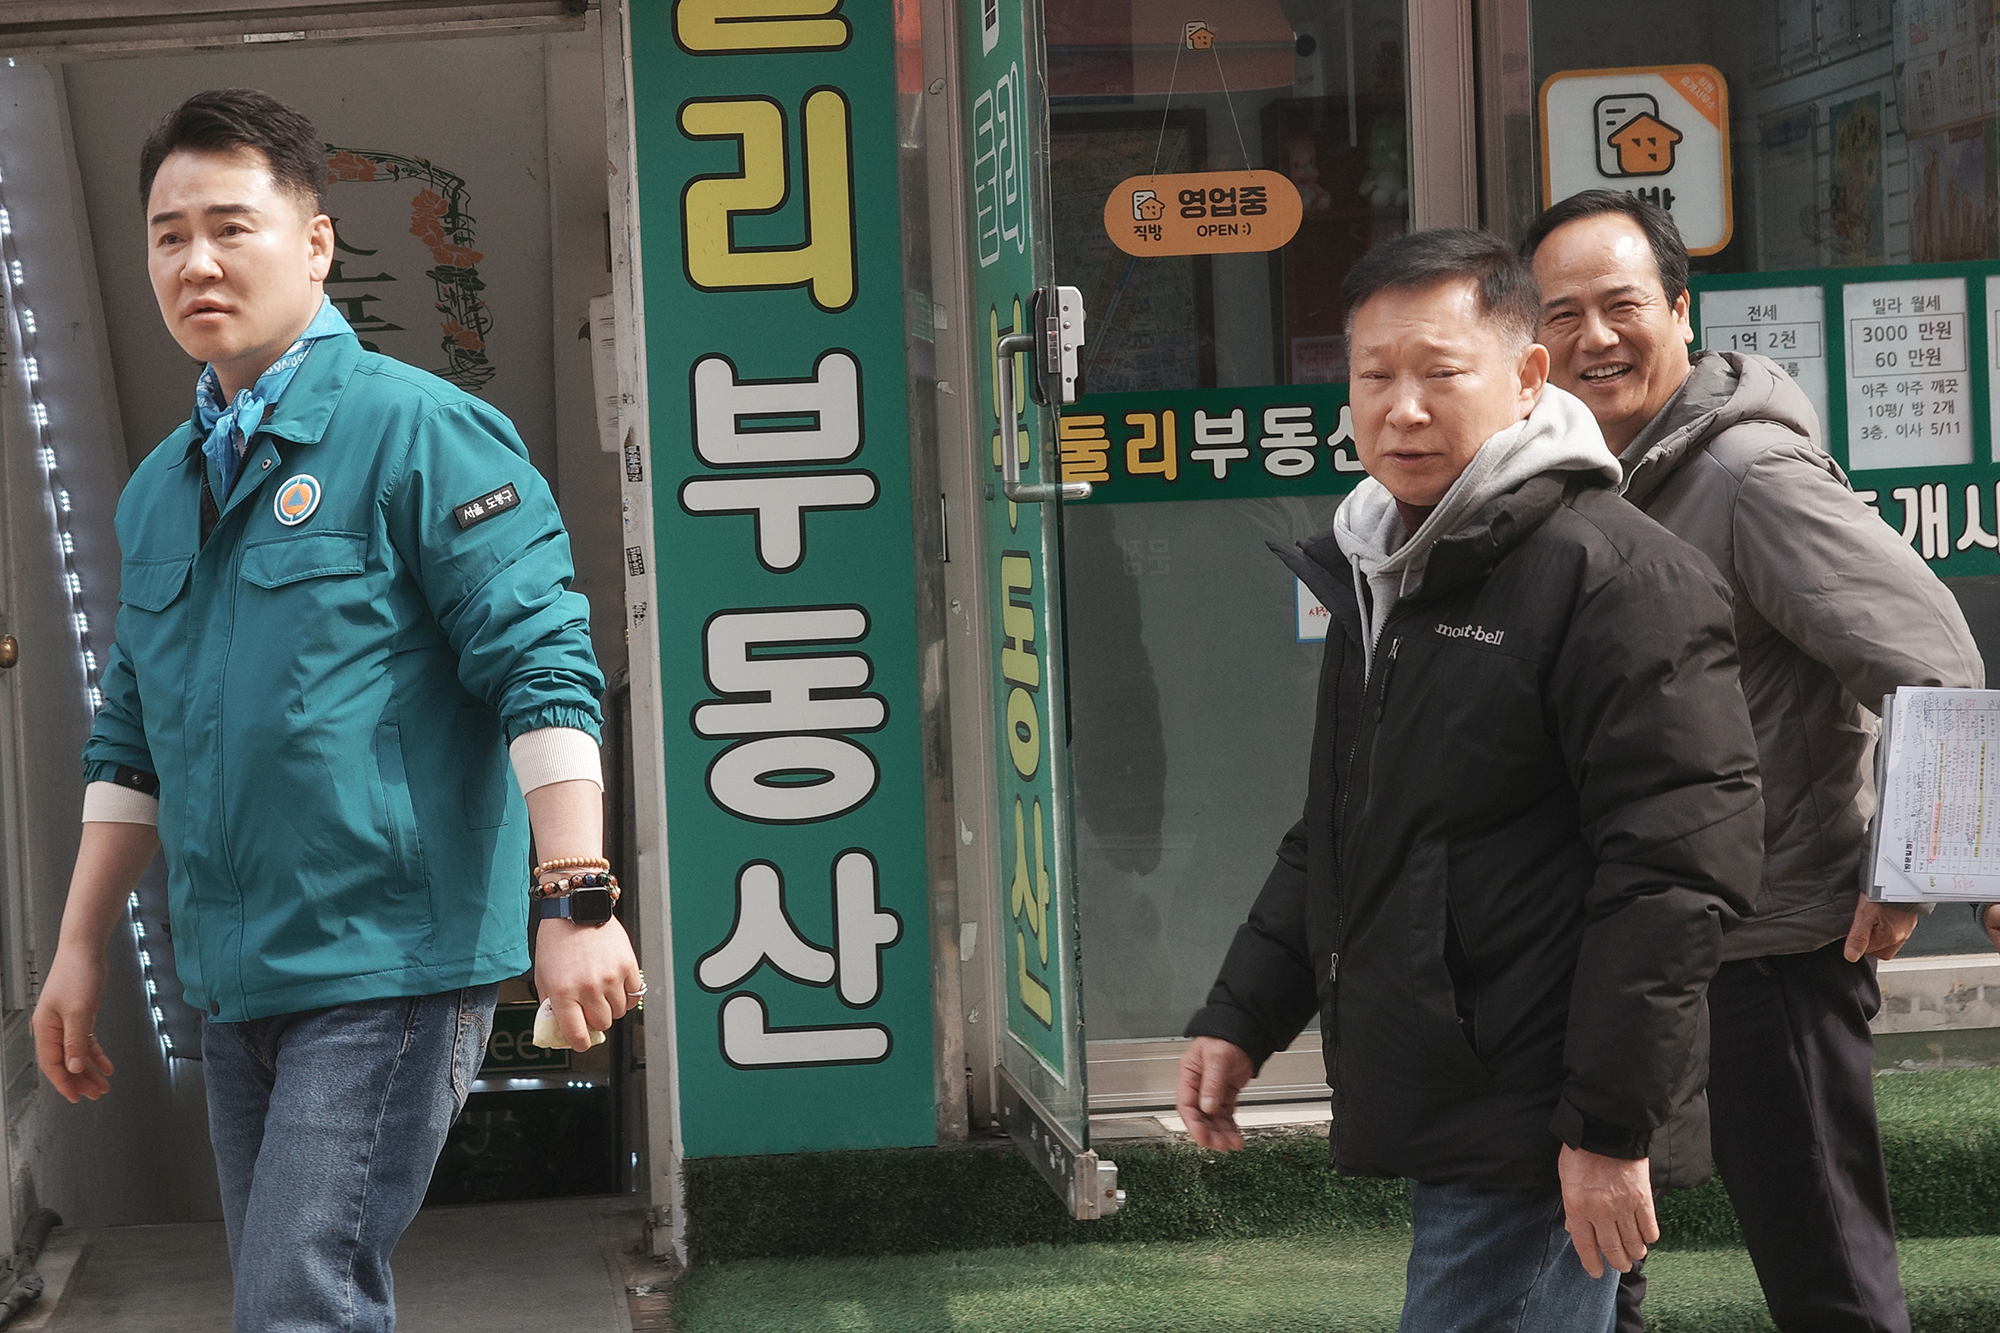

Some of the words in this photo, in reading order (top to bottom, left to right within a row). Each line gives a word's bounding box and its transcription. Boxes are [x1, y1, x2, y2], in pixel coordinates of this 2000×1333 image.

[1178, 186, 1268, 219] 영업중
[1134, 224, 1163, 242] 직방
[1197, 223, 1239, 237] OPEN
[1747, 304, 1777, 322] 전세
[1873, 297, 1902, 315] 빌라
[1911, 294, 1941, 313] 월세
[1731, 331, 1757, 351] 1억
[1769, 330, 1797, 349] 2천
[1863, 325, 1908, 343] 3000
[1919, 320, 1952, 341] 만원
[1875, 351, 1897, 368] 60
[1908, 347, 1941, 368] 만원
[1862, 383, 1889, 398] 아주
[1896, 380, 1924, 396] 아주
[1930, 378, 1959, 395] 깨끗
[1868, 403, 1904, 418] 10평/
[1912, 401, 1925, 417] 방
[1932, 399, 1955, 415] 2개
[1861, 425, 1888, 440] 3층.
[1896, 422, 1924, 439] 이사
[1931, 421, 1961, 437] 5/11
[464, 503, 484, 520] 서울
[485, 489, 513, 510] 도봉구
